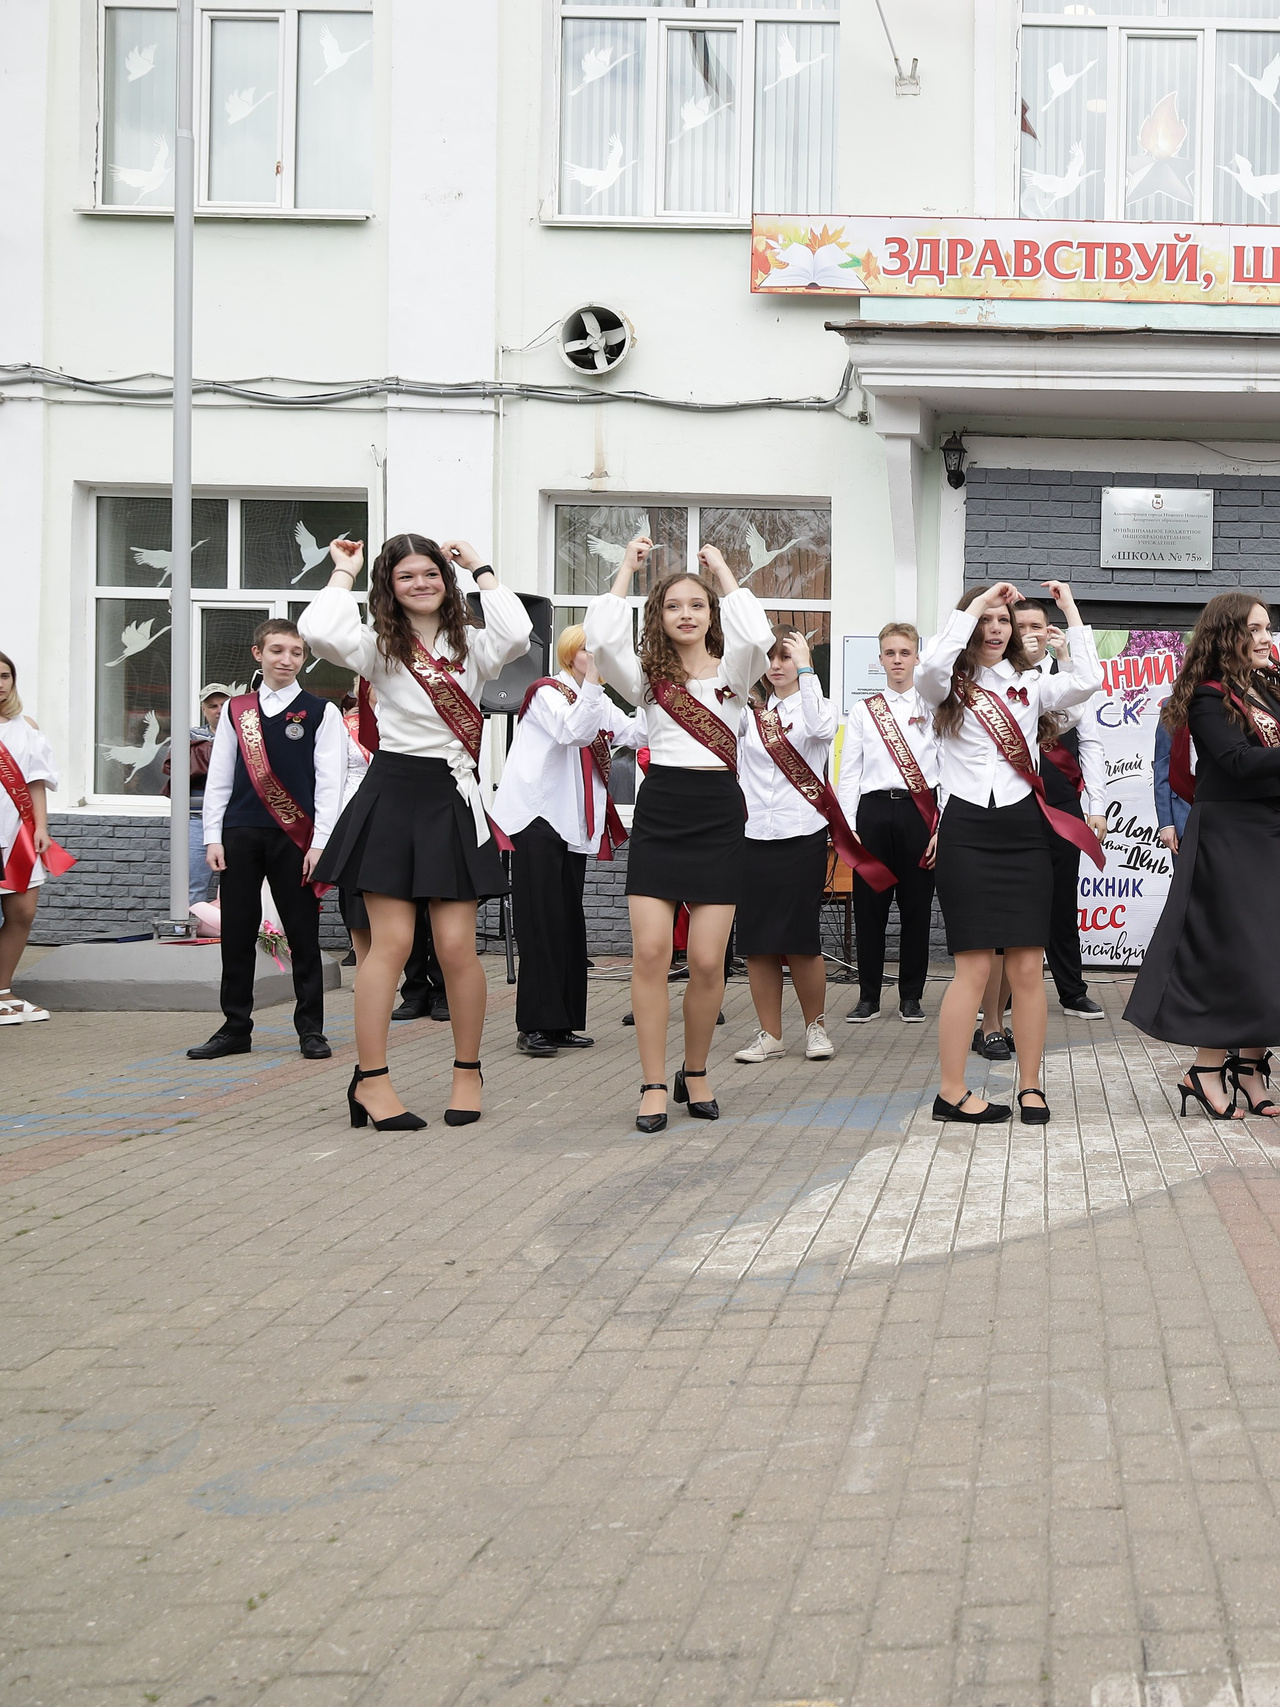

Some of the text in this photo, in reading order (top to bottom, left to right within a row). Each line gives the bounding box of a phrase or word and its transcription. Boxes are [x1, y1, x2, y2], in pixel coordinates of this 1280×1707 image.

[882, 233, 1214, 290] ЗДРАВСТВУЙ,
[1111, 551, 1202, 562] «ШКОЛА № 75»
[790, 767, 824, 800] 2025
[265, 789, 304, 824] 2025
[1078, 876, 1144, 898] СКНИК
